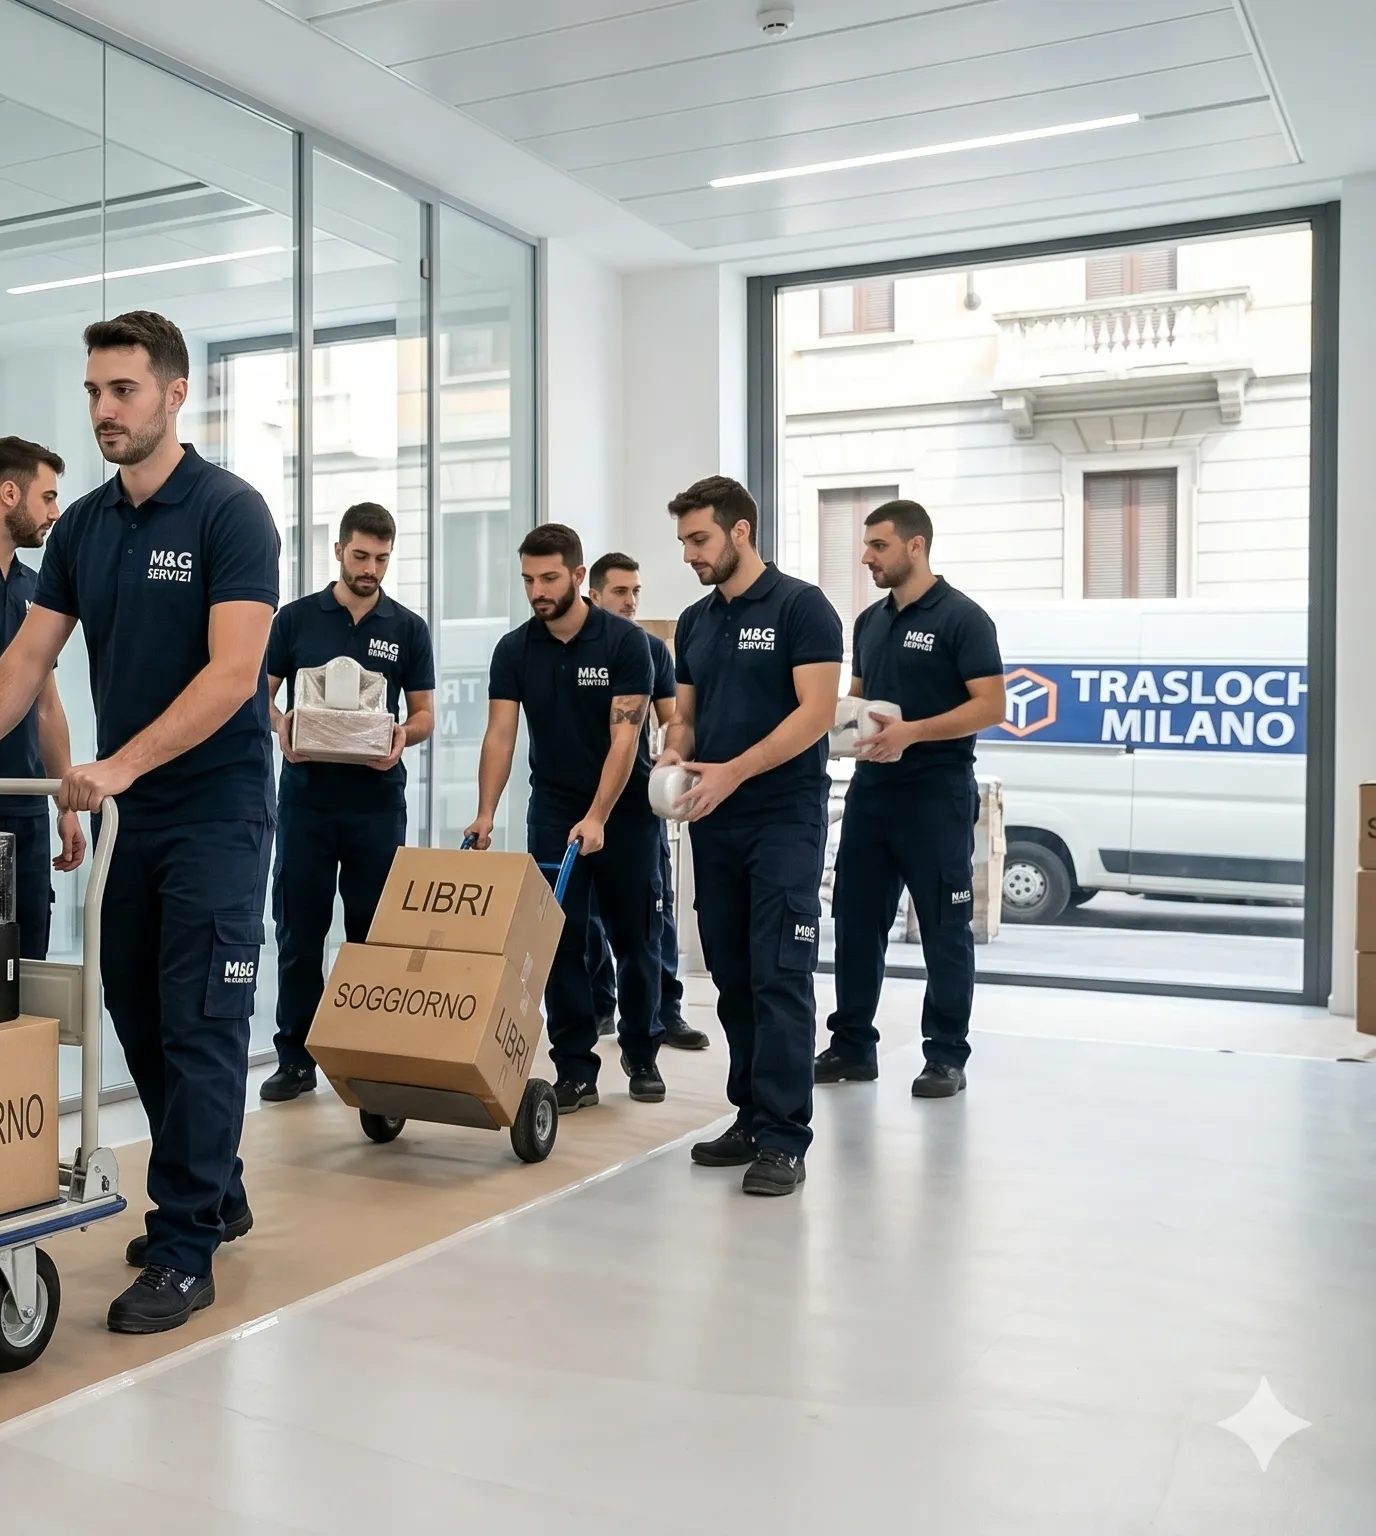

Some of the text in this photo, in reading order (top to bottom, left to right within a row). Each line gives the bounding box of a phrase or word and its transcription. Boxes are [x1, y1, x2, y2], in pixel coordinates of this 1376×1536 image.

[147, 568, 192, 583] SERVIZI
[149, 549, 193, 570] M&G
[737, 641, 775, 651] SERVIZI
[1100, 707, 1296, 747] MILANO
[401, 880, 494, 917] LIBRI
[333, 982, 477, 1022] SOGGIORNO
[494, 1007, 530, 1078] LIBRI
